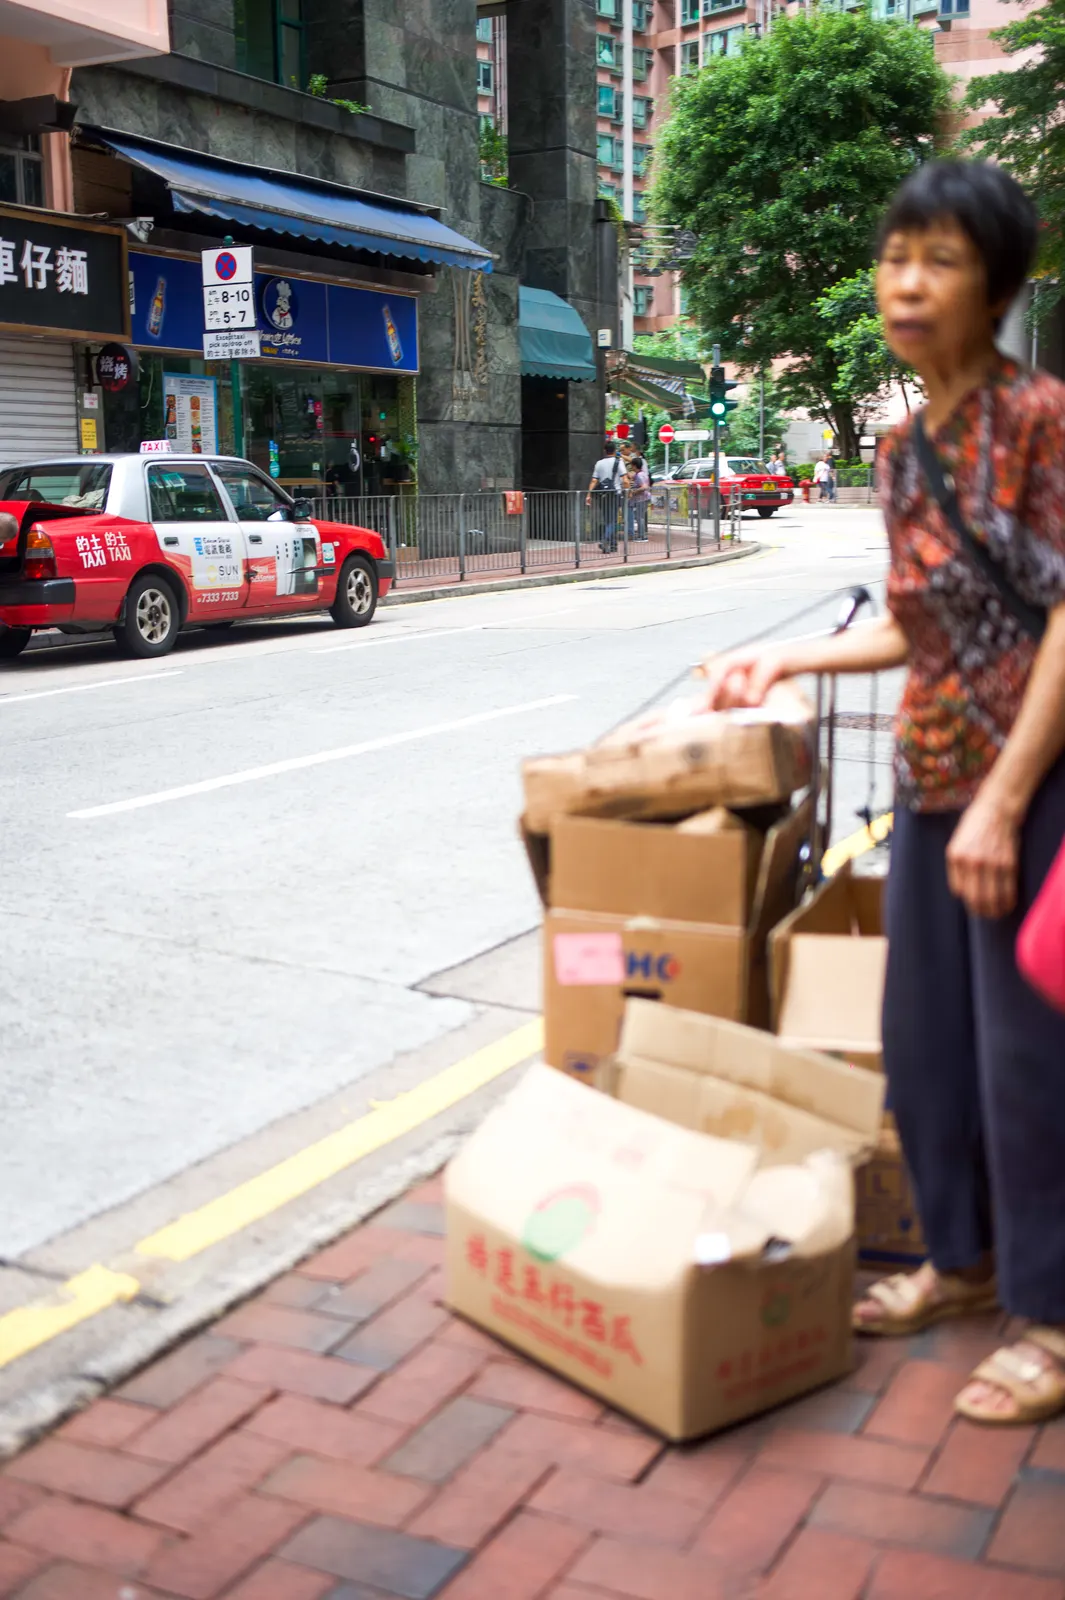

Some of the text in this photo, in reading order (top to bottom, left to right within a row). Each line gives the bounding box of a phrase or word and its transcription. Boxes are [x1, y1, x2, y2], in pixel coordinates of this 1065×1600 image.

[222, 290, 249, 303] 8-10
[142, 442, 163, 451] TAXI
[76, 531, 128, 551] 的士 的士
[79, 546, 131, 568] TAXI TAXI
[218, 565, 239, 576] SUN
[201, 590, 239, 603] 7333 7333
